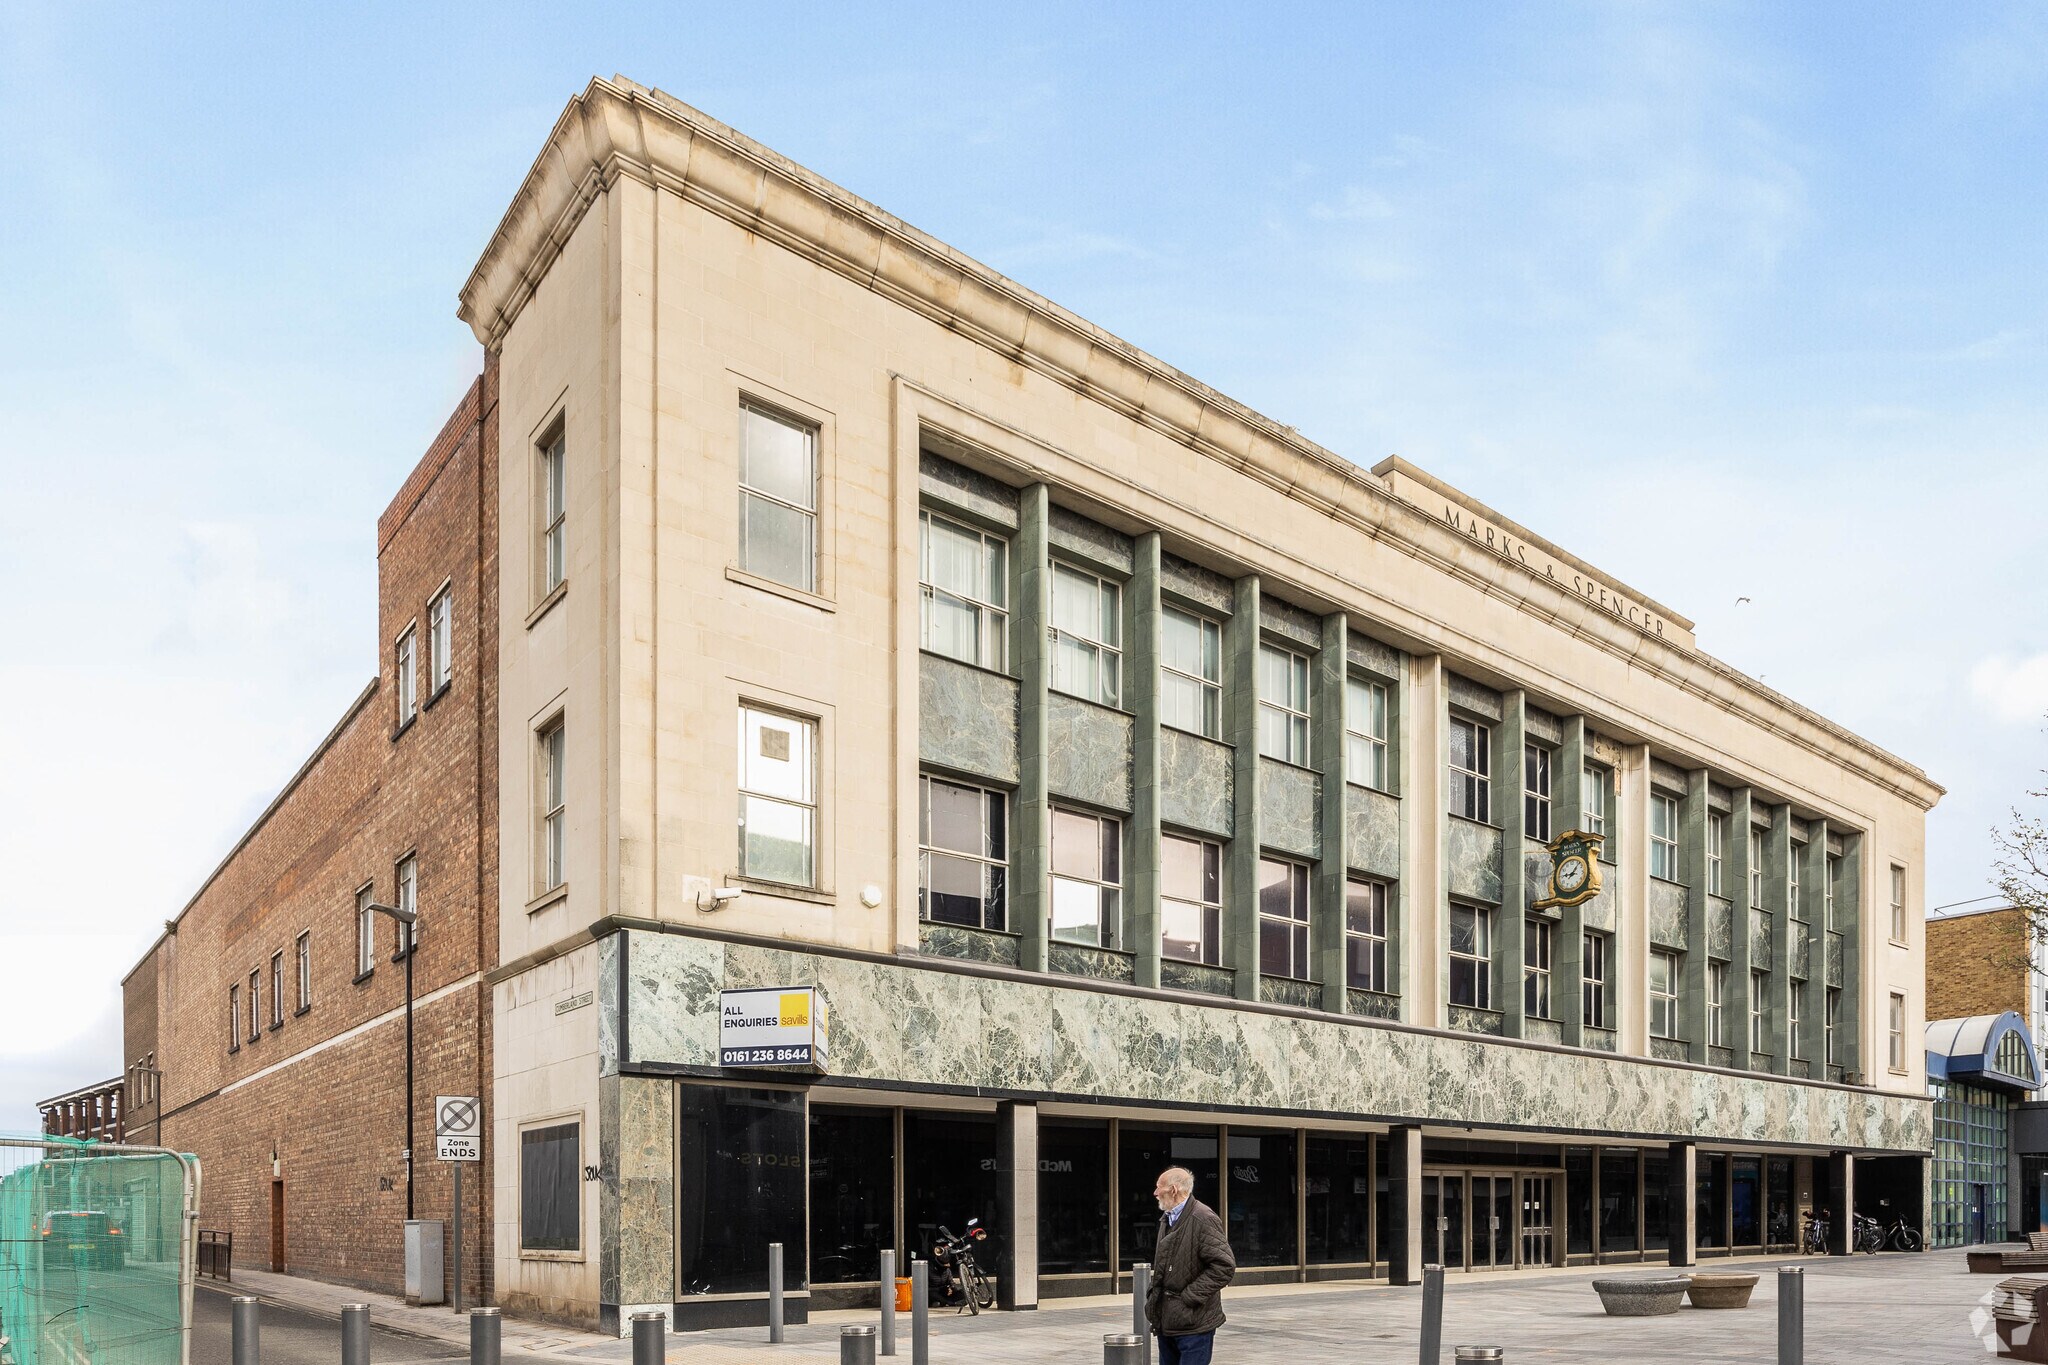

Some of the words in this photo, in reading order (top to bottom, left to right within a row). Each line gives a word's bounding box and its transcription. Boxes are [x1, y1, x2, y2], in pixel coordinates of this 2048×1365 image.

[1445, 505, 1526, 564] MARKS
[1546, 564, 1555, 579] &
[1573, 575, 1665, 637] SPENCER
[579, 994, 592, 1005] STREET
[724, 1006, 743, 1016] ALL
[724, 1017, 778, 1028] ENQUIRIES
[781, 1014, 808, 1026] savills
[723, 1050, 749, 1062] 0161
[751, 1050, 774, 1062] 236
[777, 1048, 809, 1061] 8644
[447, 1138, 470, 1147] Zone
[441, 1148, 476, 1158] ENDS
